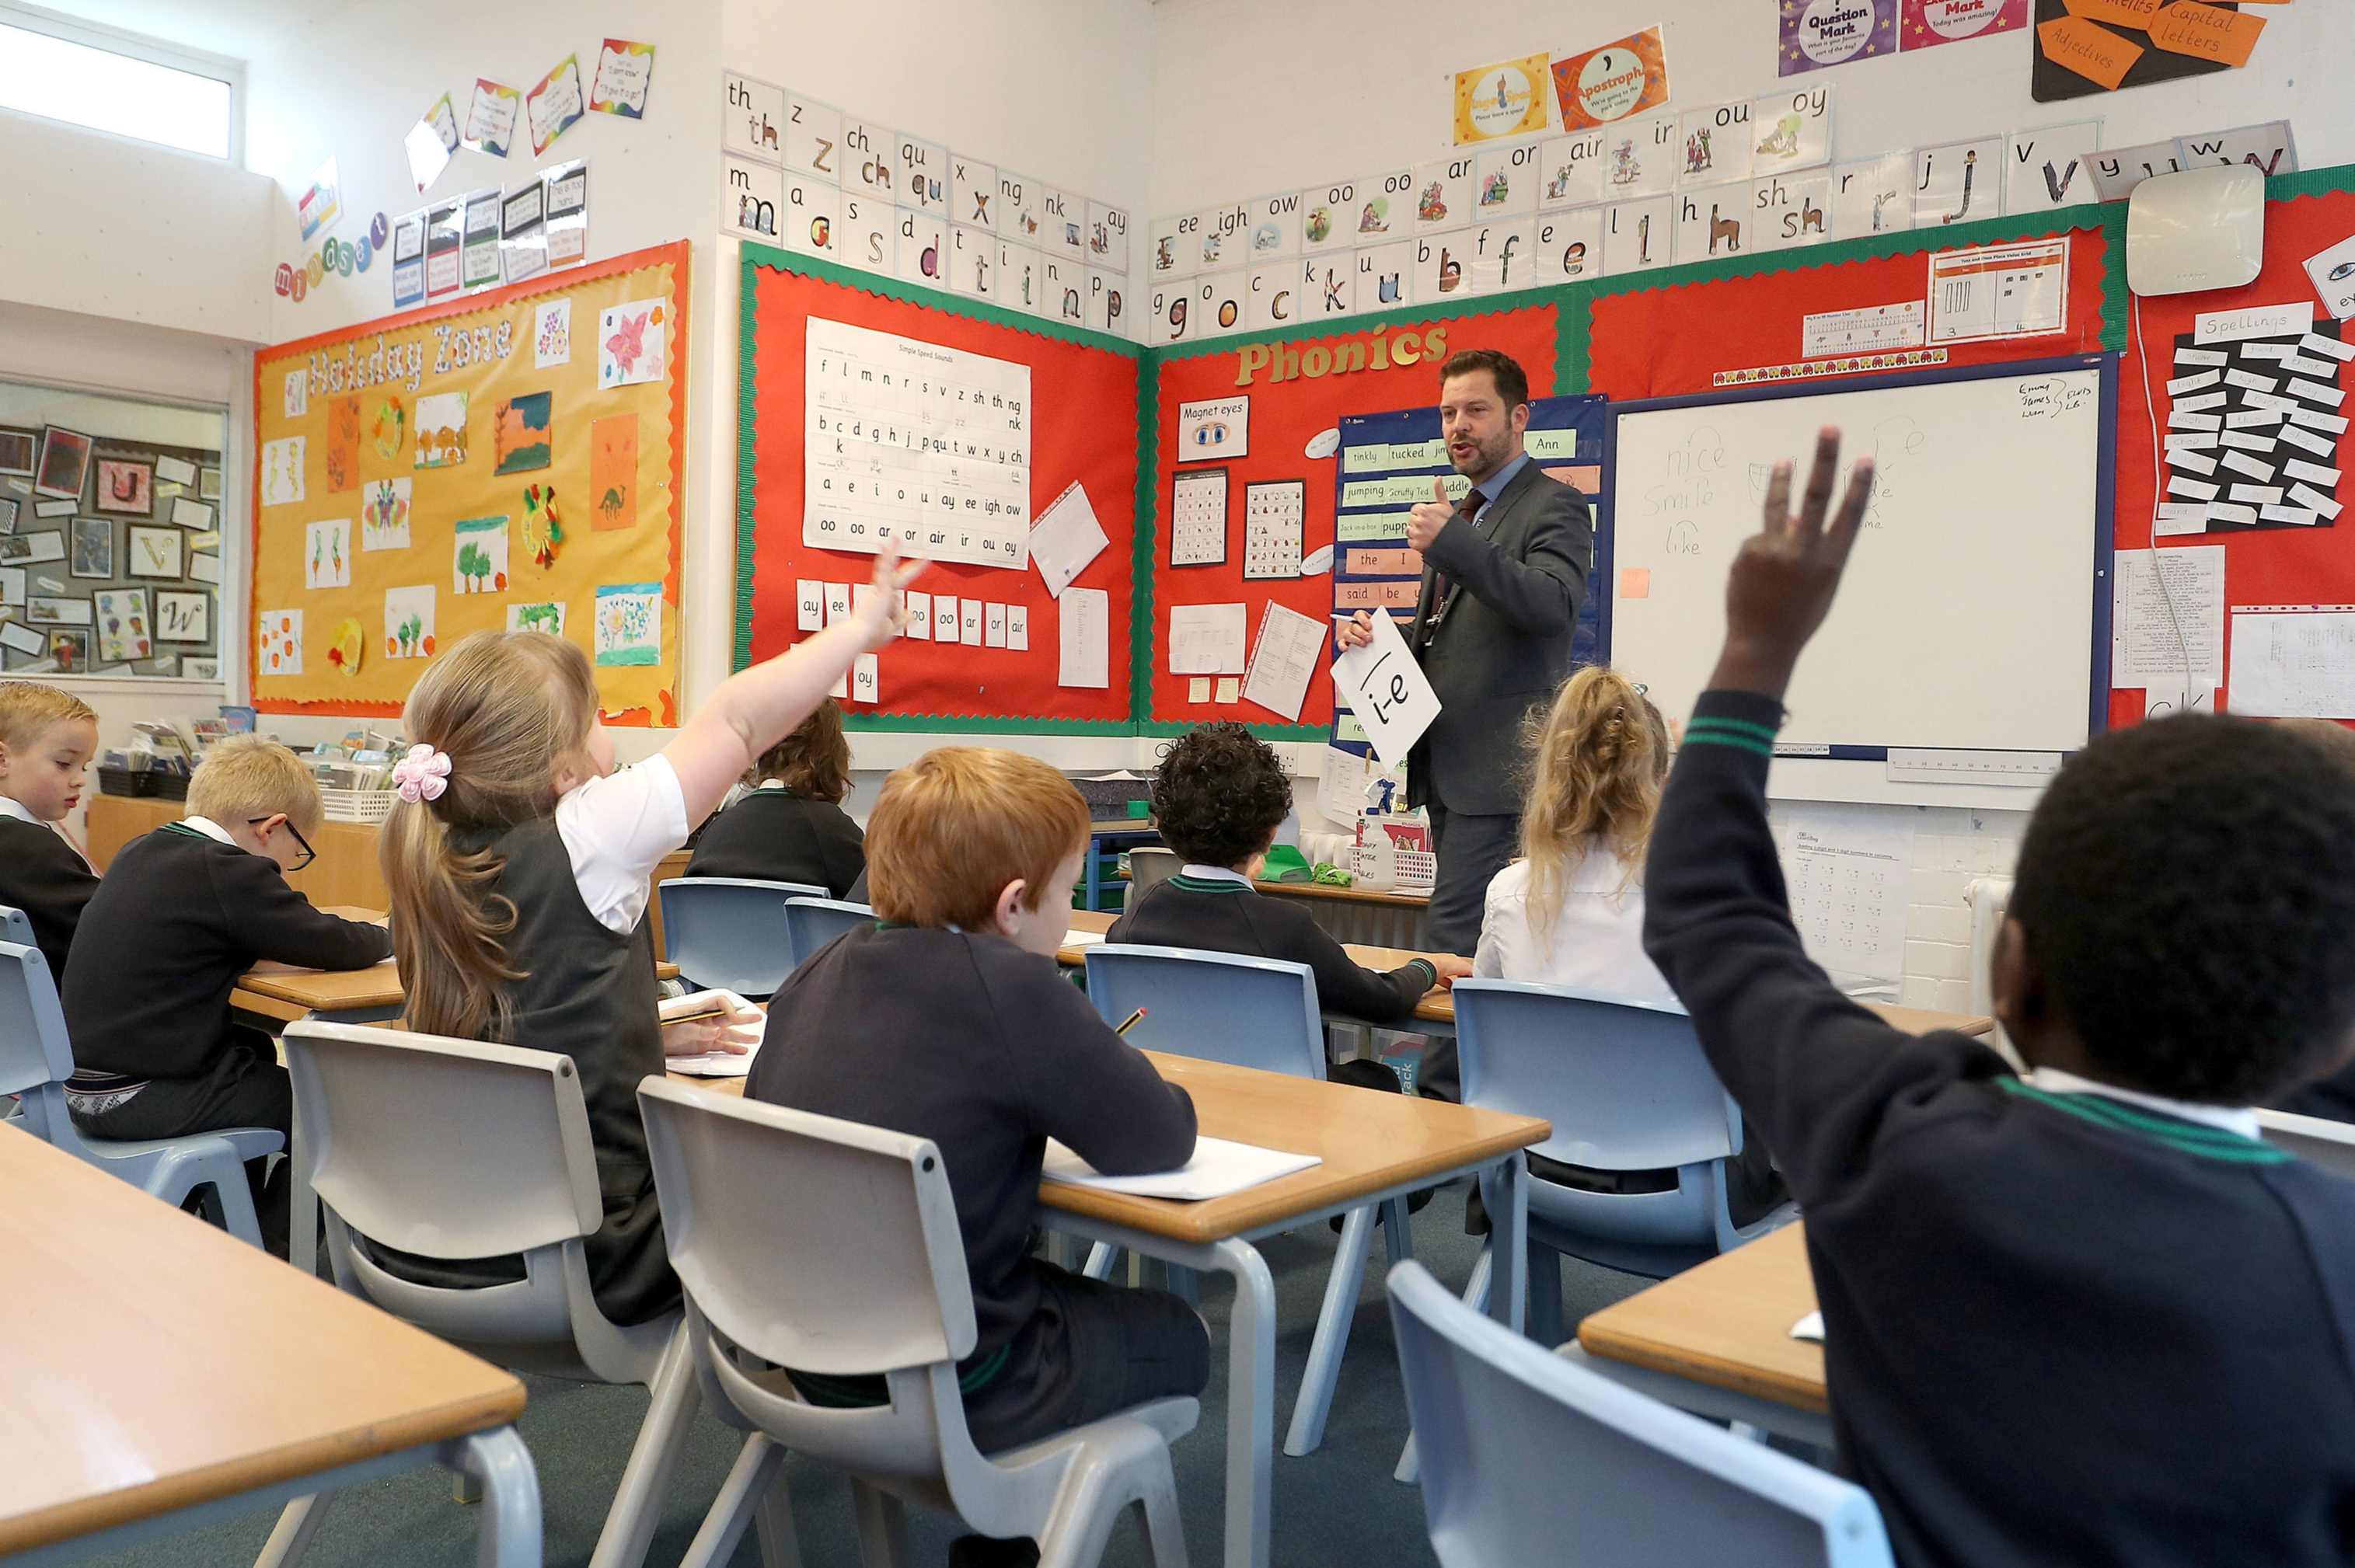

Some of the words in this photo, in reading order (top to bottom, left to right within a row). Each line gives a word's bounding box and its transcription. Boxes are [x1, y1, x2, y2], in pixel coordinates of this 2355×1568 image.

[1945, 1, 1984, 16] Mark
[2170, 2, 2235, 33] Capital
[1809, 9, 1868, 28] Question
[1933, 19, 1952, 28] Today
[1968, 9, 1997, 22] amazing!
[1820, 25, 1855, 39] Mark
[2052, 28, 2114, 69] Adjectives
[728, 80, 752, 110] th
[846, 125, 870, 153] ch
[902, 143, 926, 169] qu
[1001, 179, 1022, 207] ng
[1045, 193, 1065, 218] nk
[1108, 211, 1126, 235] ay
[1178, 217, 1198, 234] ee
[1219, 205, 1247, 237] igh
[1269, 195, 1299, 215] ow
[1328, 185, 1353, 204] oo
[1384, 174, 1411, 193] oo
[1448, 159, 1472, 179] ar
[1512, 145, 1537, 166] or
[1570, 135, 1603, 161] air
[1655, 120, 1673, 145] ir
[1715, 104, 1750, 127] ou
[1792, 89, 1826, 118] oy
[1756, 178, 1788, 209] sh
[2206, 316, 2287, 336] Spellings
[310, 333, 423, 395] Holiday
[434, 320, 511, 374] Zone
[899, 345, 916, 354] Simple
[917, 348, 933, 359] Speed
[934, 353, 953, 363] Sounds
[1234, 323, 1446, 385] Phonics
[973, 390, 985, 405] sh
[993, 394, 1003, 409] th
[1008, 401, 1021, 416] ng
[1183, 406, 1218, 421] Magnet
[1220, 403, 1243, 417] eyes
[1009, 416, 1021, 430] nk
[932, 439, 947, 454] qu
[1010, 449, 1023, 464] ch
[1536, 437, 1559, 450] Ann
[1353, 451, 1377, 464] tinkly
[1391, 446, 1424, 459] tucked
[1433, 446, 1448, 458] jim
[1347, 485, 1383, 499] jumping
[1390, 488, 1414, 497] Scruffy
[1417, 487, 1429, 496] Ted
[1445, 482, 1469, 491] uddle
[941, 495, 955, 510] ay
[965, 499, 977, 510] ee
[985, 499, 1001, 516] igh
[1006, 504, 1021, 516] ow
[1383, 522, 1407, 535] pupp
[820, 520, 836, 531] oo
[850, 523, 865, 535] oo
[878, 527, 891, 538] ar
[905, 530, 917, 541] or
[929, 531, 946, 544] air
[961, 533, 969, 546] ir
[982, 539, 996, 550] ou
[1004, 542, 1017, 557] oy
[1360, 552, 1378, 566] the
[1347, 587, 1369, 600] said
[1387, 586, 1400, 599] be
[803, 601, 818, 617] ay
[832, 601, 845, 612] ee
[939, 614, 954, 625] oo
[965, 618, 976, 628] ar
[990, 619, 1002, 630] or
[1011, 620, 1024, 633] air
[858, 672, 873, 688] oy
